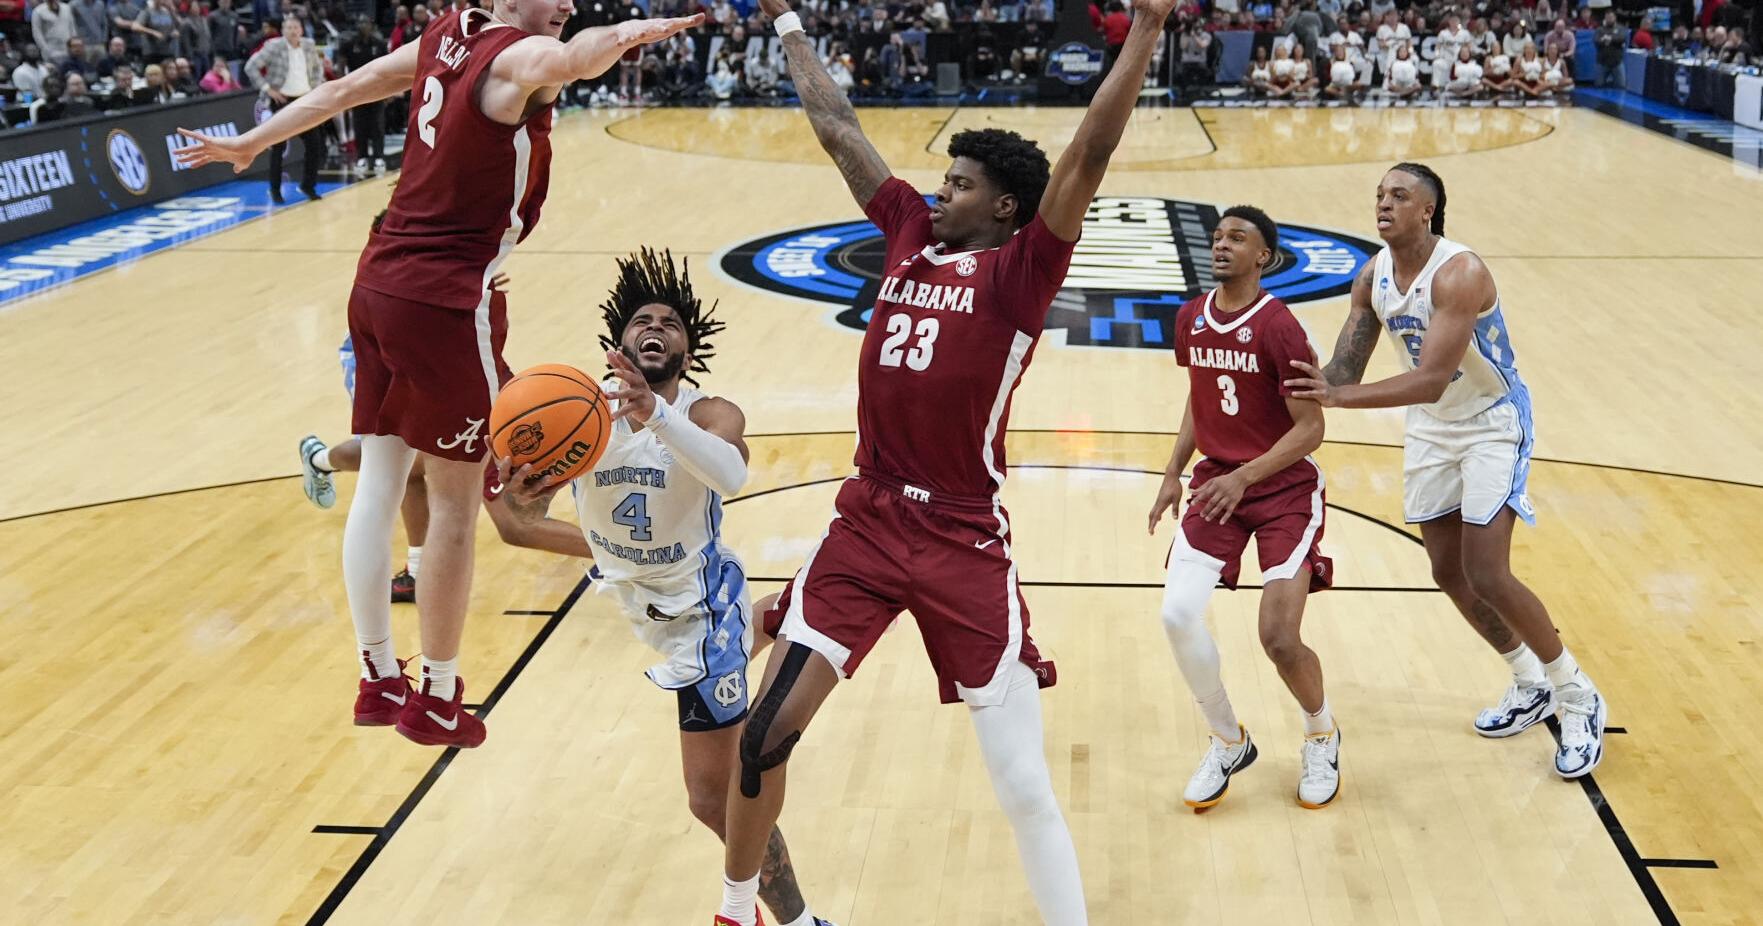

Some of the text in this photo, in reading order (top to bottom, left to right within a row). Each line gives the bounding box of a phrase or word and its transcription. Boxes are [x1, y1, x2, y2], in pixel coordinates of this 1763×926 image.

[435, 35, 470, 70] NELSN
[417, 76, 444, 150] 2
[1061, 198, 1188, 292] MADNESS
[957, 256, 977, 276] SEC
[877, 275, 976, 314] ALABAMA
[879, 313, 940, 372] 23
[1236, 326, 1253, 343] SEC
[1189, 346, 1260, 373] ALABAMA
[1216, 374, 1240, 416] 3
[594, 466, 667, 489] NORTH
[903, 484, 931, 504] RTR
[612, 492, 652, 541] 4
[590, 530, 687, 566] CAROLINA
